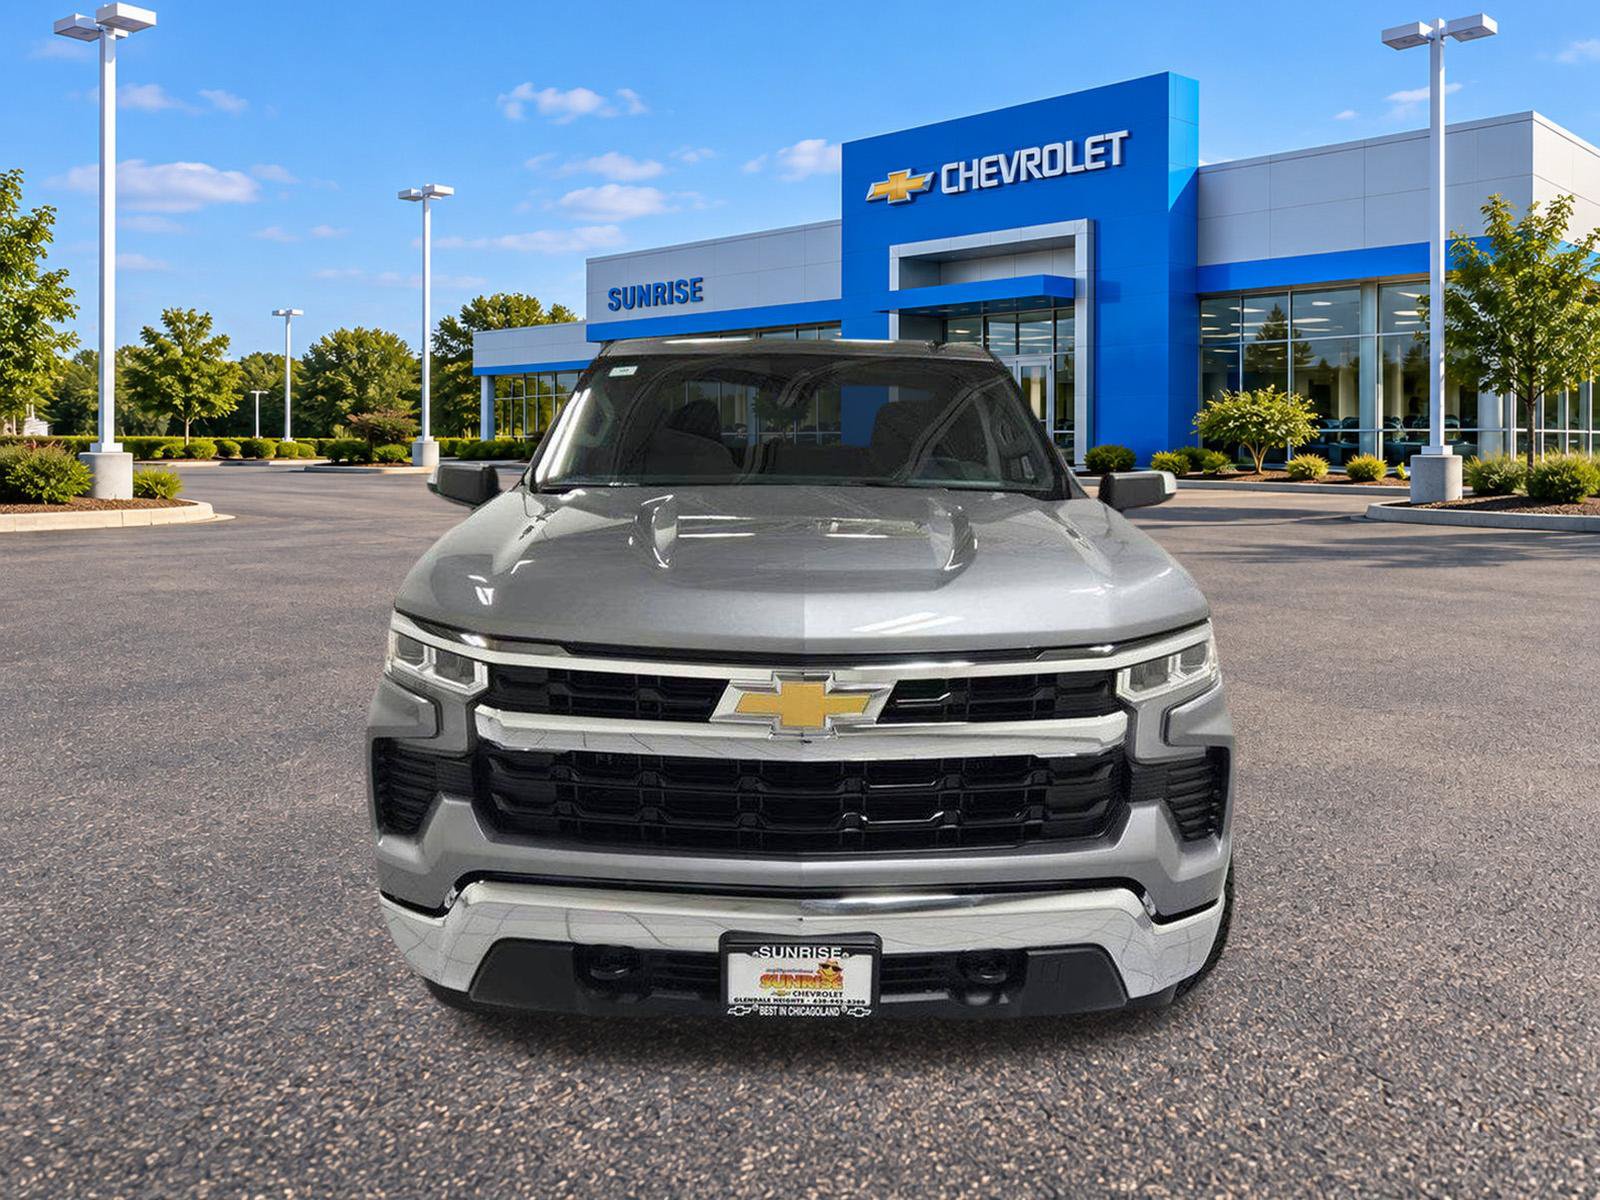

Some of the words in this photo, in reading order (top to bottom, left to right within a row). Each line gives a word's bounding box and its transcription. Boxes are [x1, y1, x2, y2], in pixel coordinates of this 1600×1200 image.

[941, 129, 1129, 195] CHEVROLET
[608, 277, 704, 311] SUNRISE
[759, 946, 842, 959] SUNRISE
[760, 974, 844, 990] SUNRISE
[792, 990, 844, 998] CHEVROLET
[759, 1005, 778, 1016] BEST
[779, 1006, 788, 1016] IN
[788, 1006, 840, 1017] CHICAGOLAND
